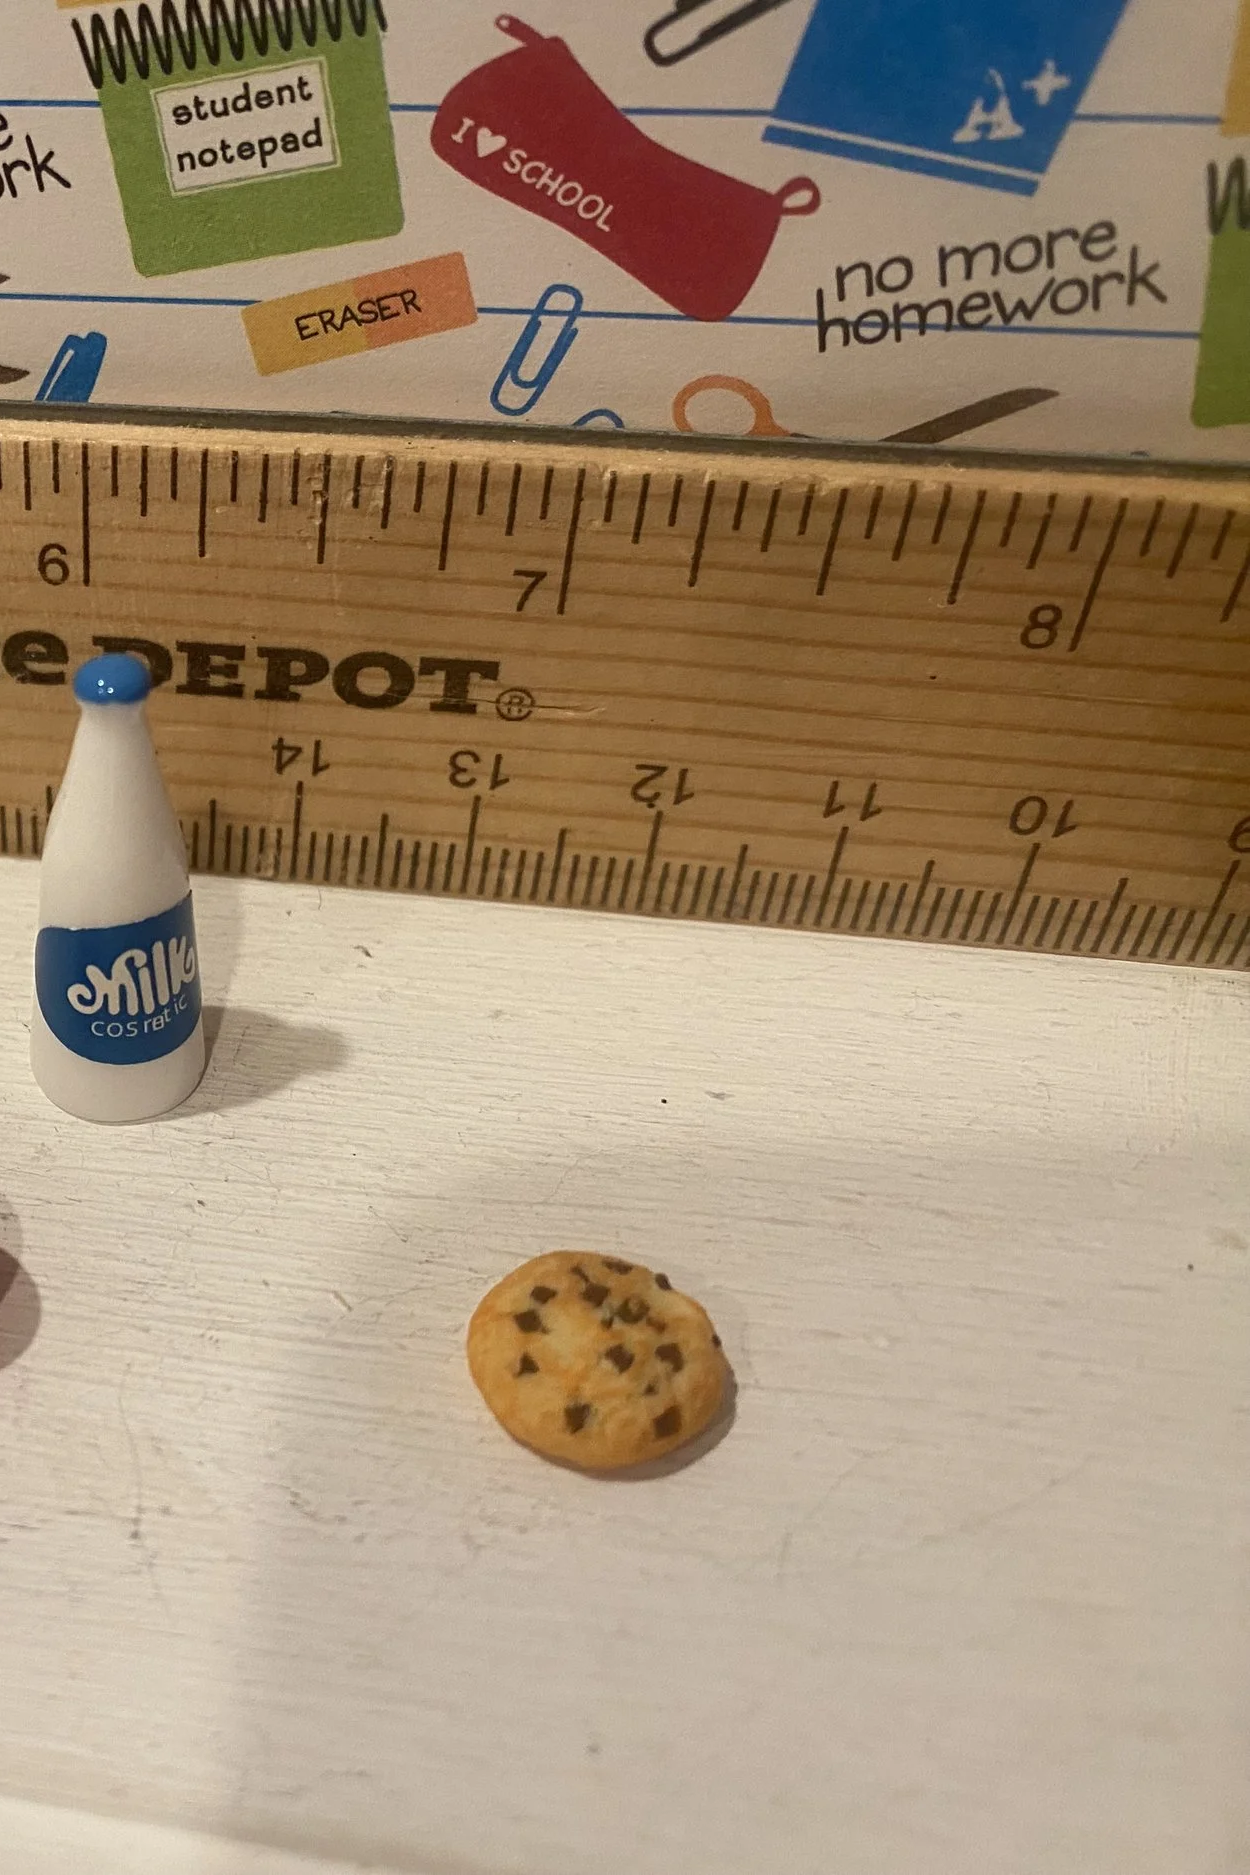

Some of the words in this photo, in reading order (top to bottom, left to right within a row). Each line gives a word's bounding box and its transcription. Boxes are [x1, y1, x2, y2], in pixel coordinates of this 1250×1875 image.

[172, 76, 313, 126] student
[177, 119, 324, 173] notepad
[451, 117, 473, 144] I
[502, 149, 617, 232] SCHOOL
[816, 245, 1168, 352] homework
[836, 255, 912, 300] no
[939, 220, 1117, 287] more
[294, 289, 421, 341] ERASER
[38, 543, 70, 585] 6
[512, 569, 548, 612] 7
[1019, 604, 1063, 649] 8
[272, 736, 330, 777] 14
[448, 749, 511, 791] 13
[630, 763, 695, 806] 12
[822, 780, 883, 822] 11
[1009, 796, 1079, 839] 10
[67, 936, 196, 1016] Milk
